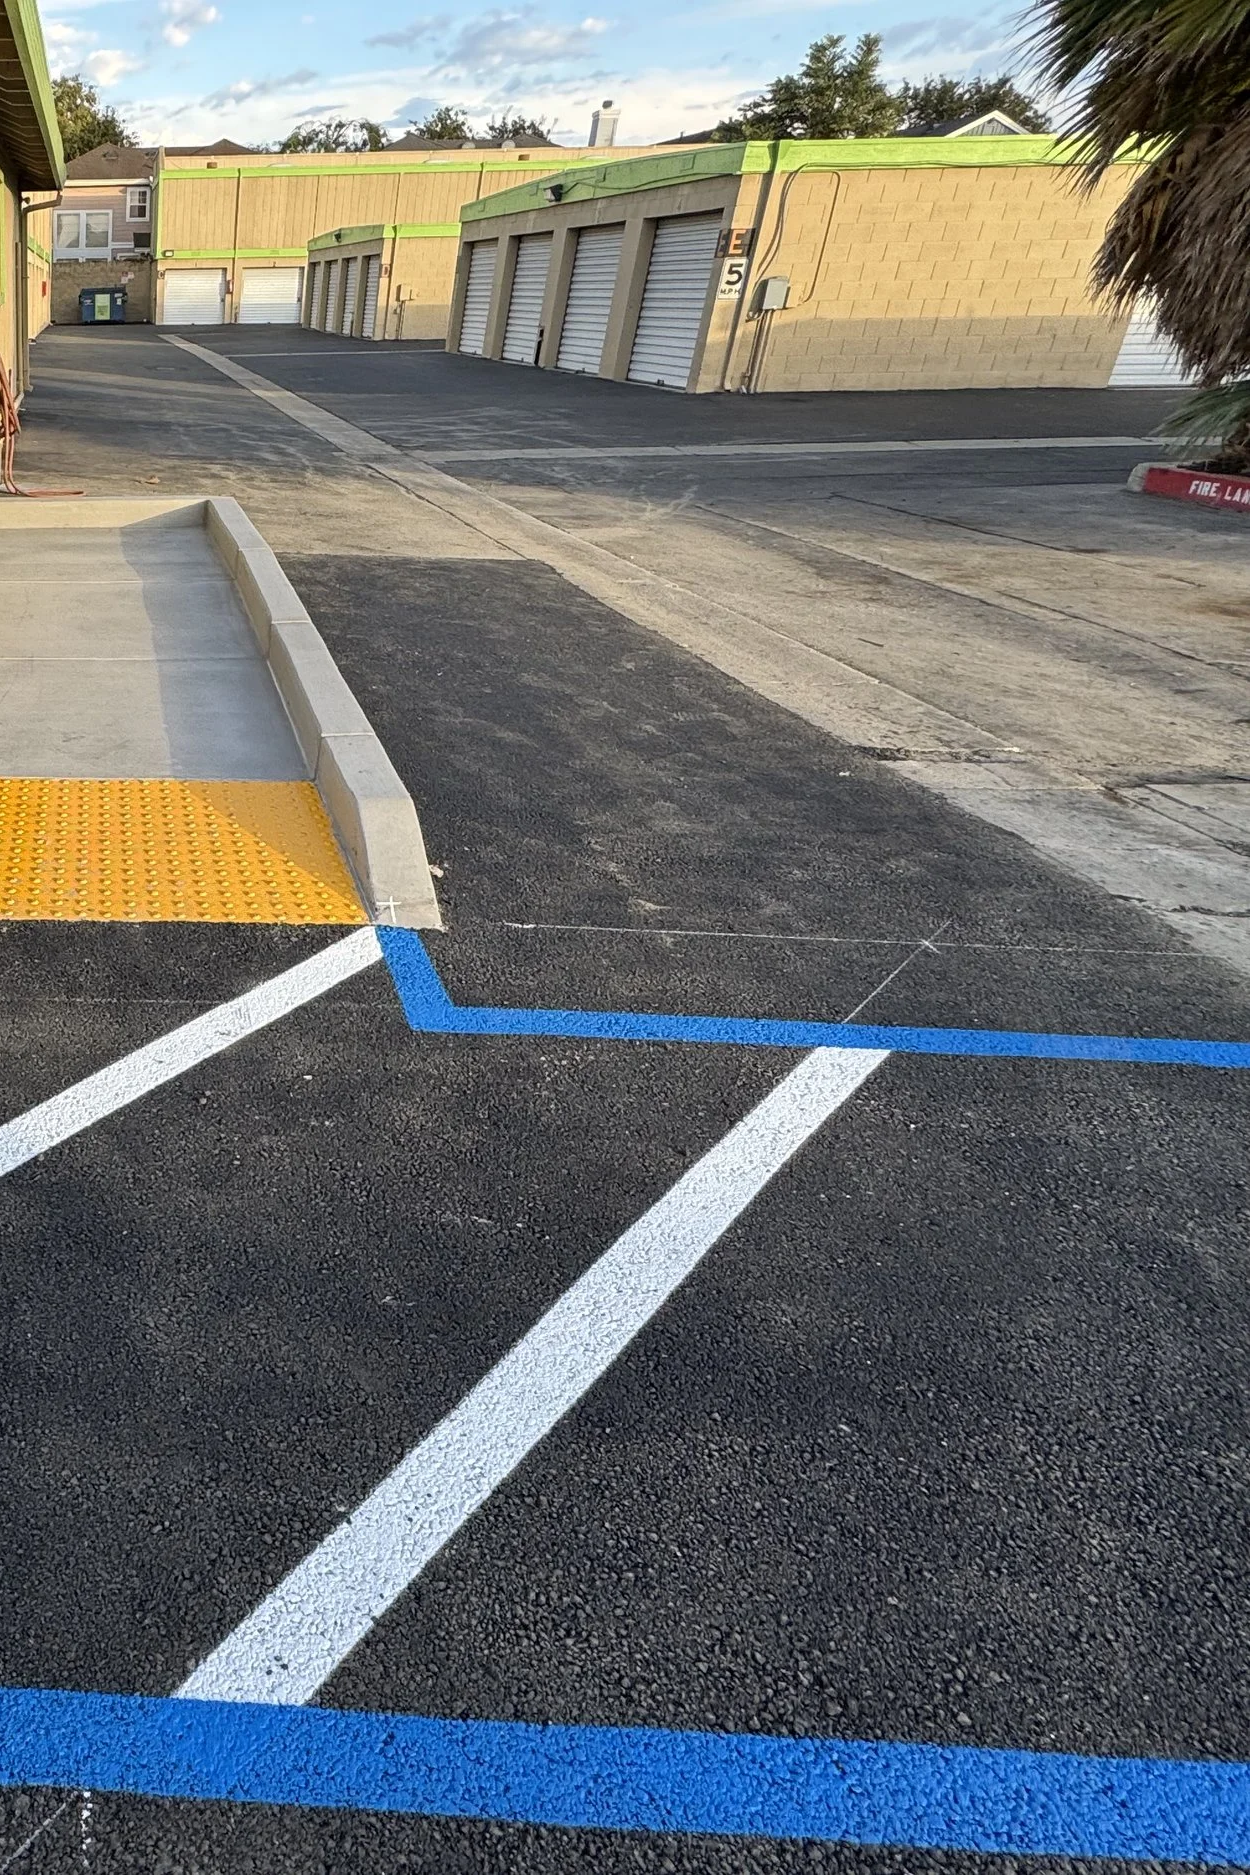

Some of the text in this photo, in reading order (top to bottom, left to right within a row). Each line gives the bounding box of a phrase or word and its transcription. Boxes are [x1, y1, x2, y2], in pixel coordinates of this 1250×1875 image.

[729, 229, 747, 254] E
[725, 263, 743, 286] 5
[1188, 480, 1220, 497] FIRE
